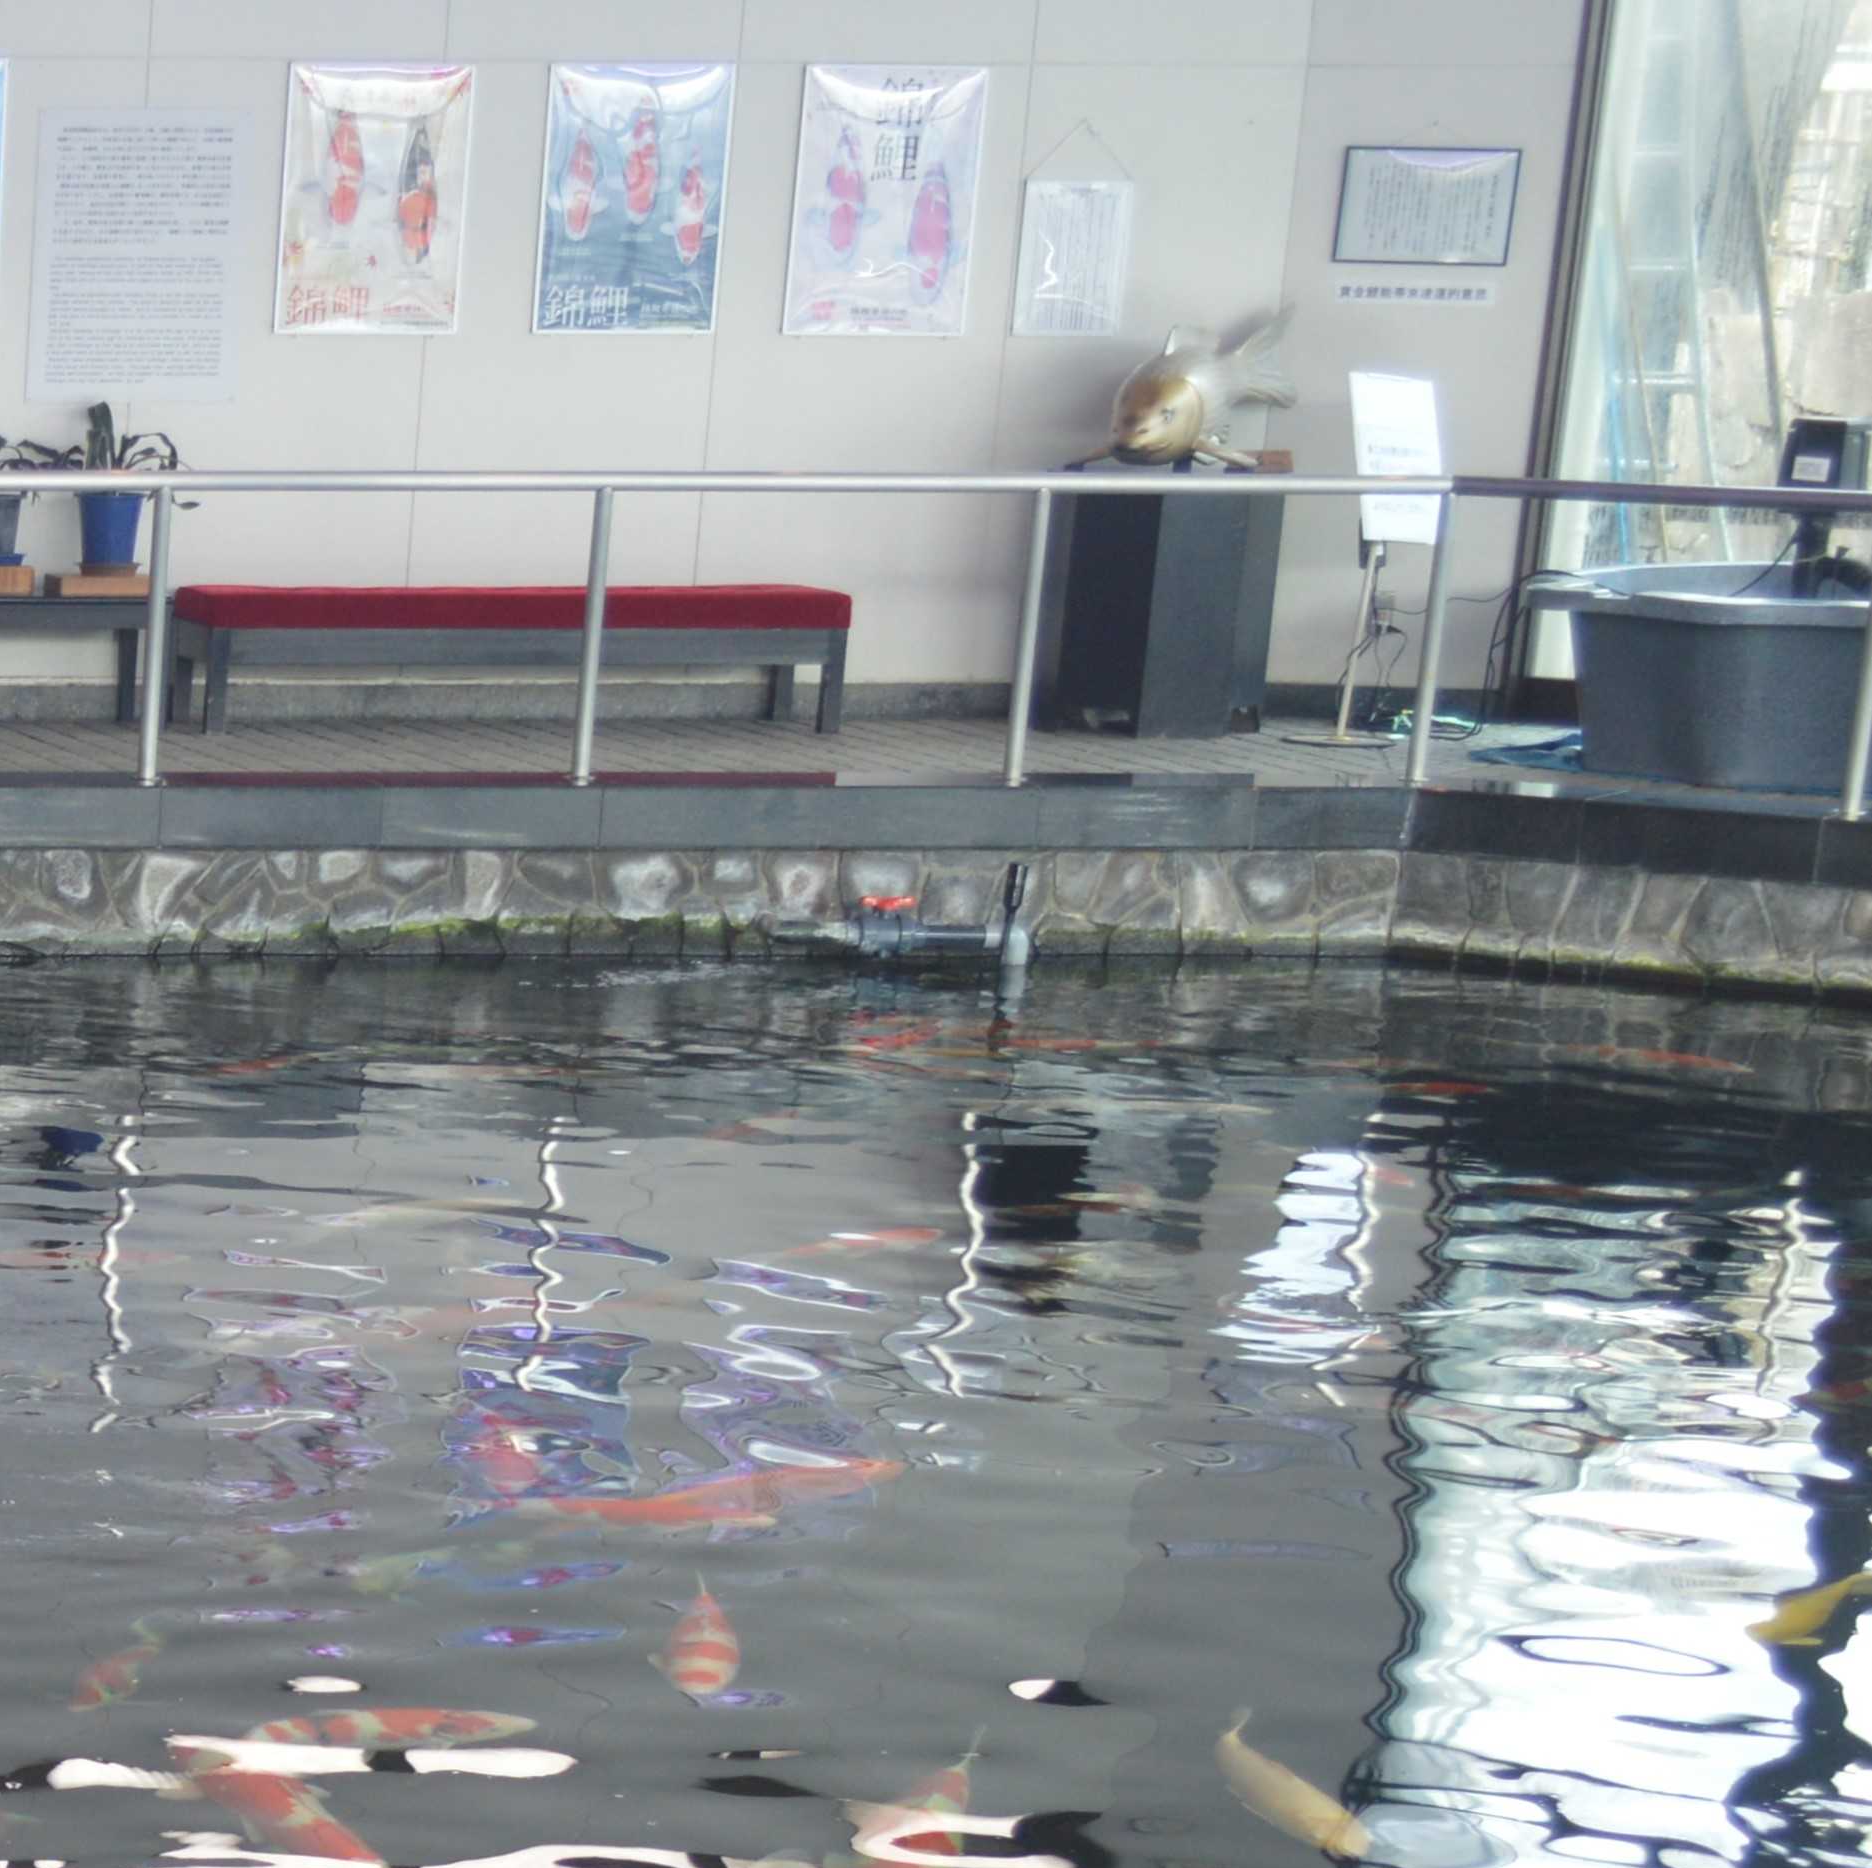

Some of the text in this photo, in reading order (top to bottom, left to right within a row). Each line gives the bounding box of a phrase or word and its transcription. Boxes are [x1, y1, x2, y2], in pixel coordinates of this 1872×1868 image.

[870, 77, 925, 181] 錦鯉
[286, 284, 370, 325] 錦鯉
[542, 284, 629, 327] 錦鯉
